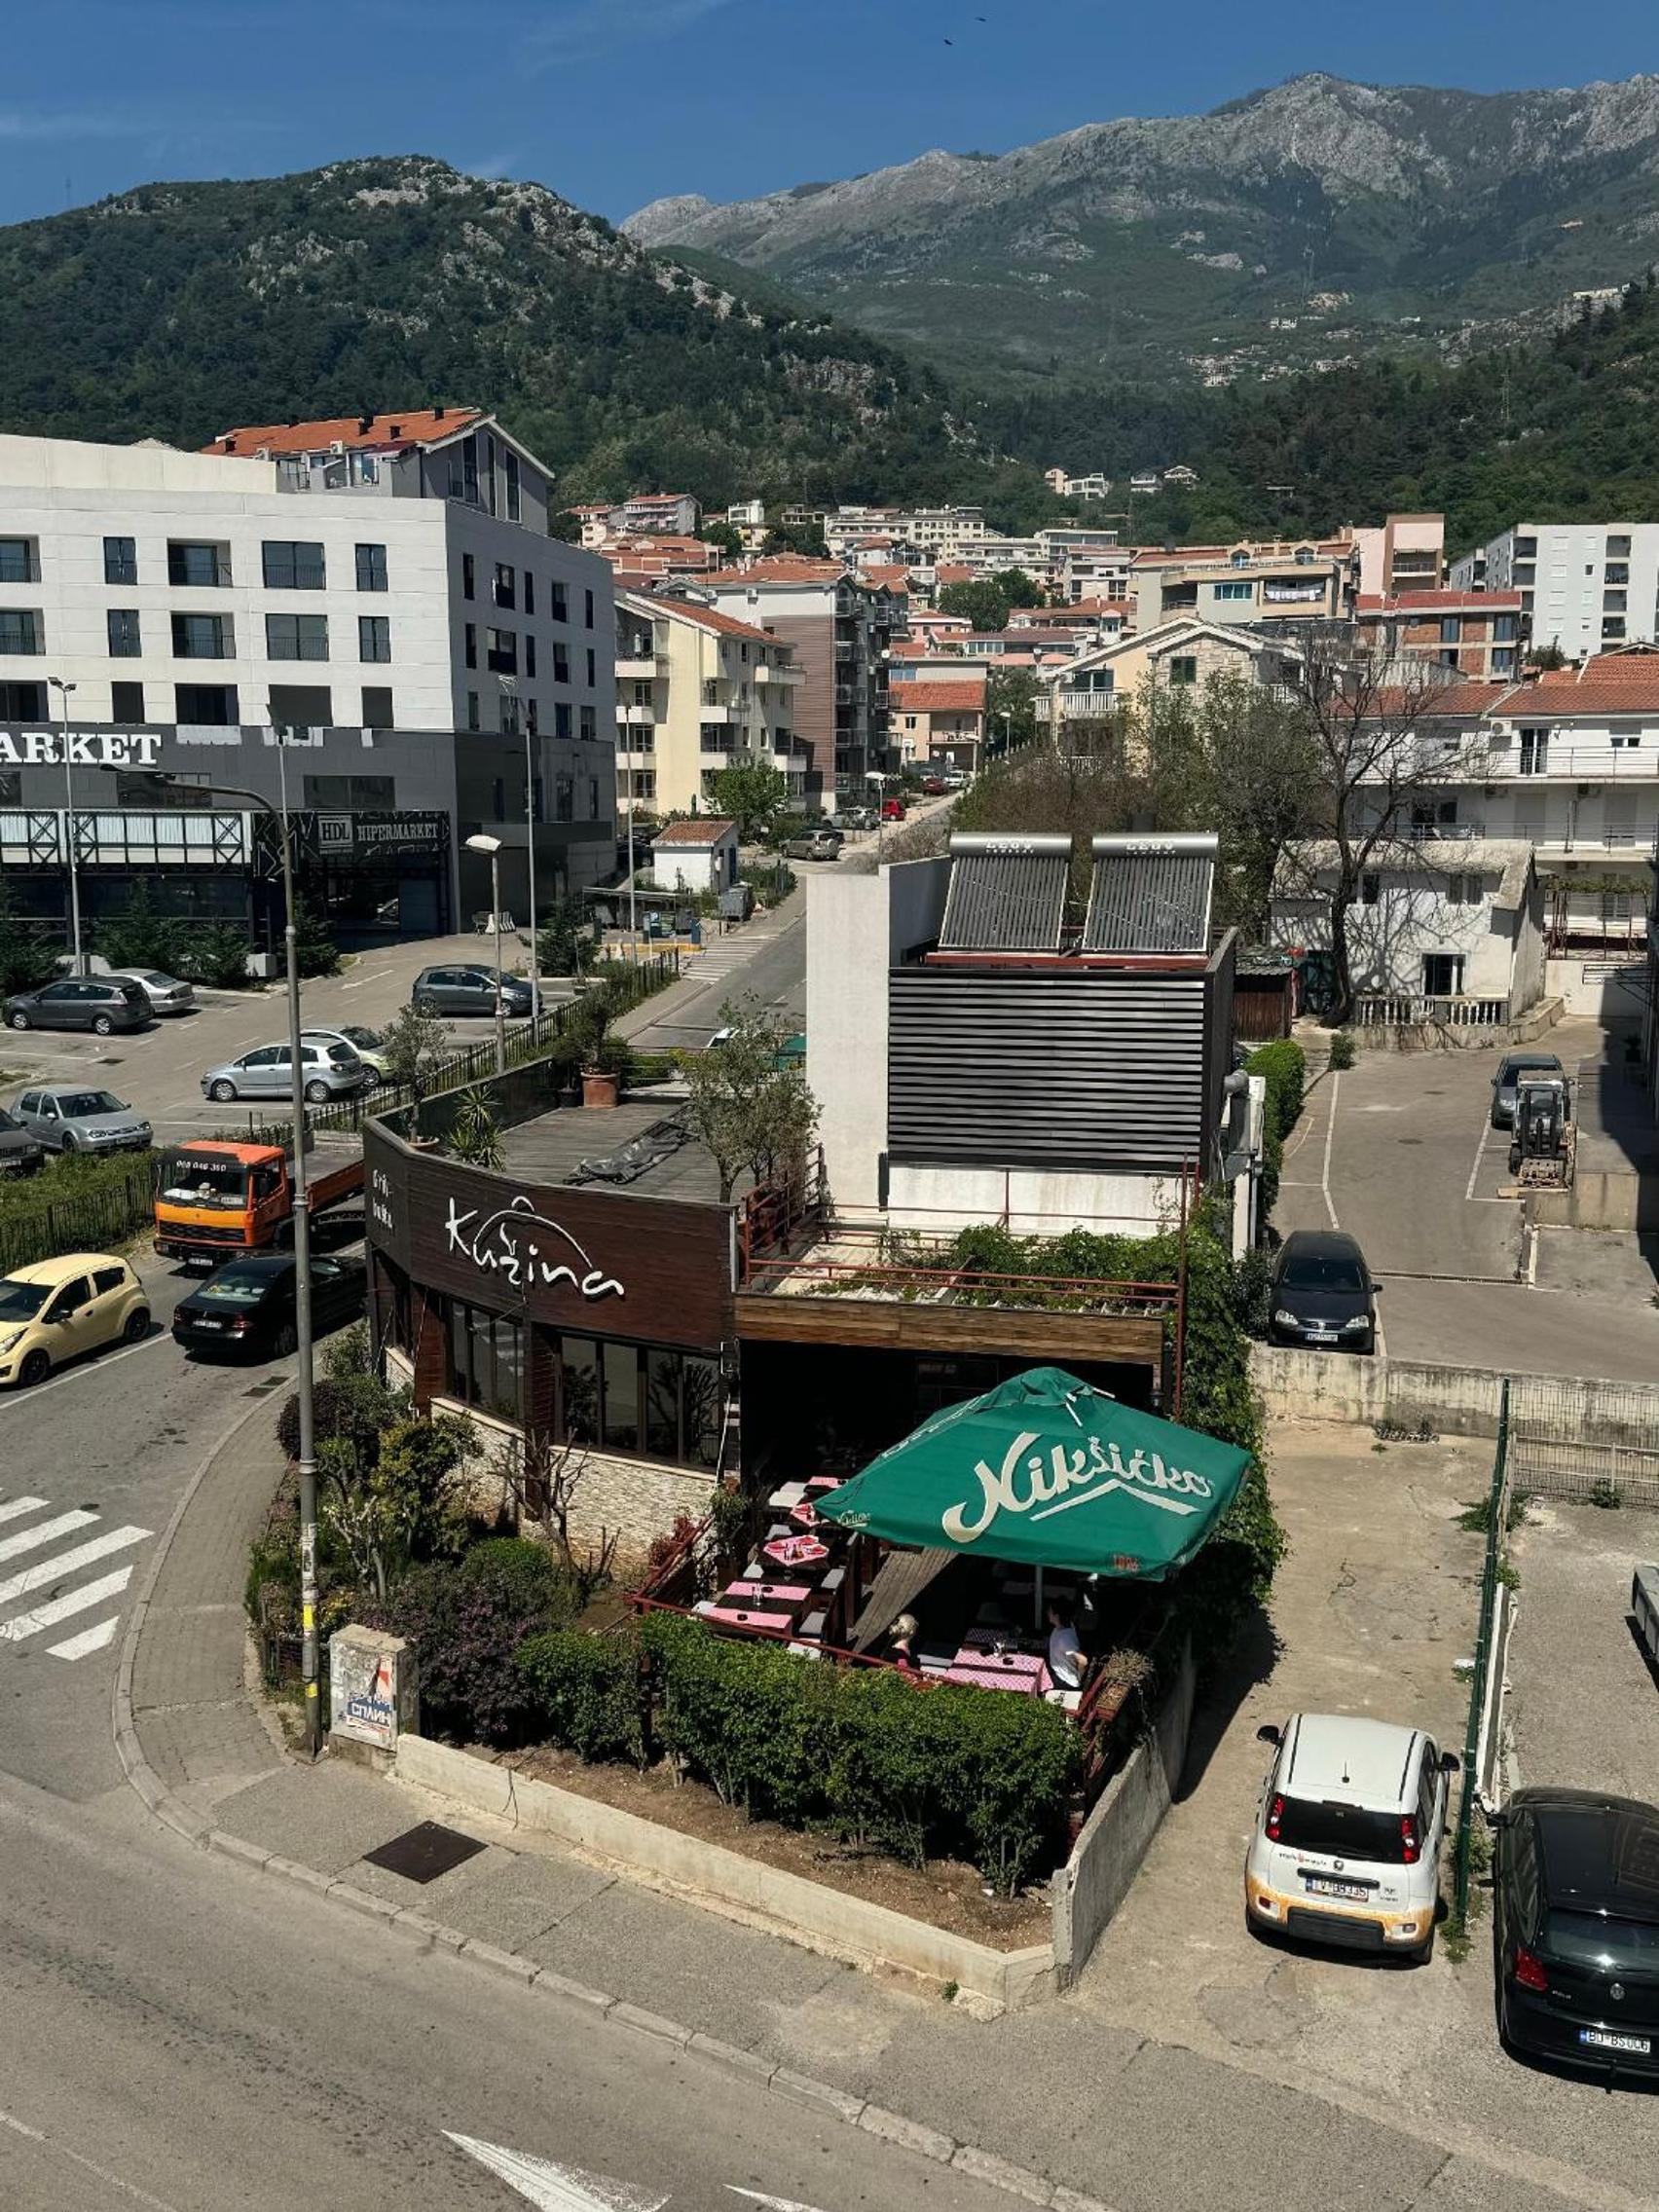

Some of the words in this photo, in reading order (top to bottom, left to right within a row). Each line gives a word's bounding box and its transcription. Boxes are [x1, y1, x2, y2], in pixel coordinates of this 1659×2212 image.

[321, 822, 350, 840] HDL
[356, 823, 438, 841] HIPERMARKET
[941, 1431, 1212, 1544] Nikšićko
